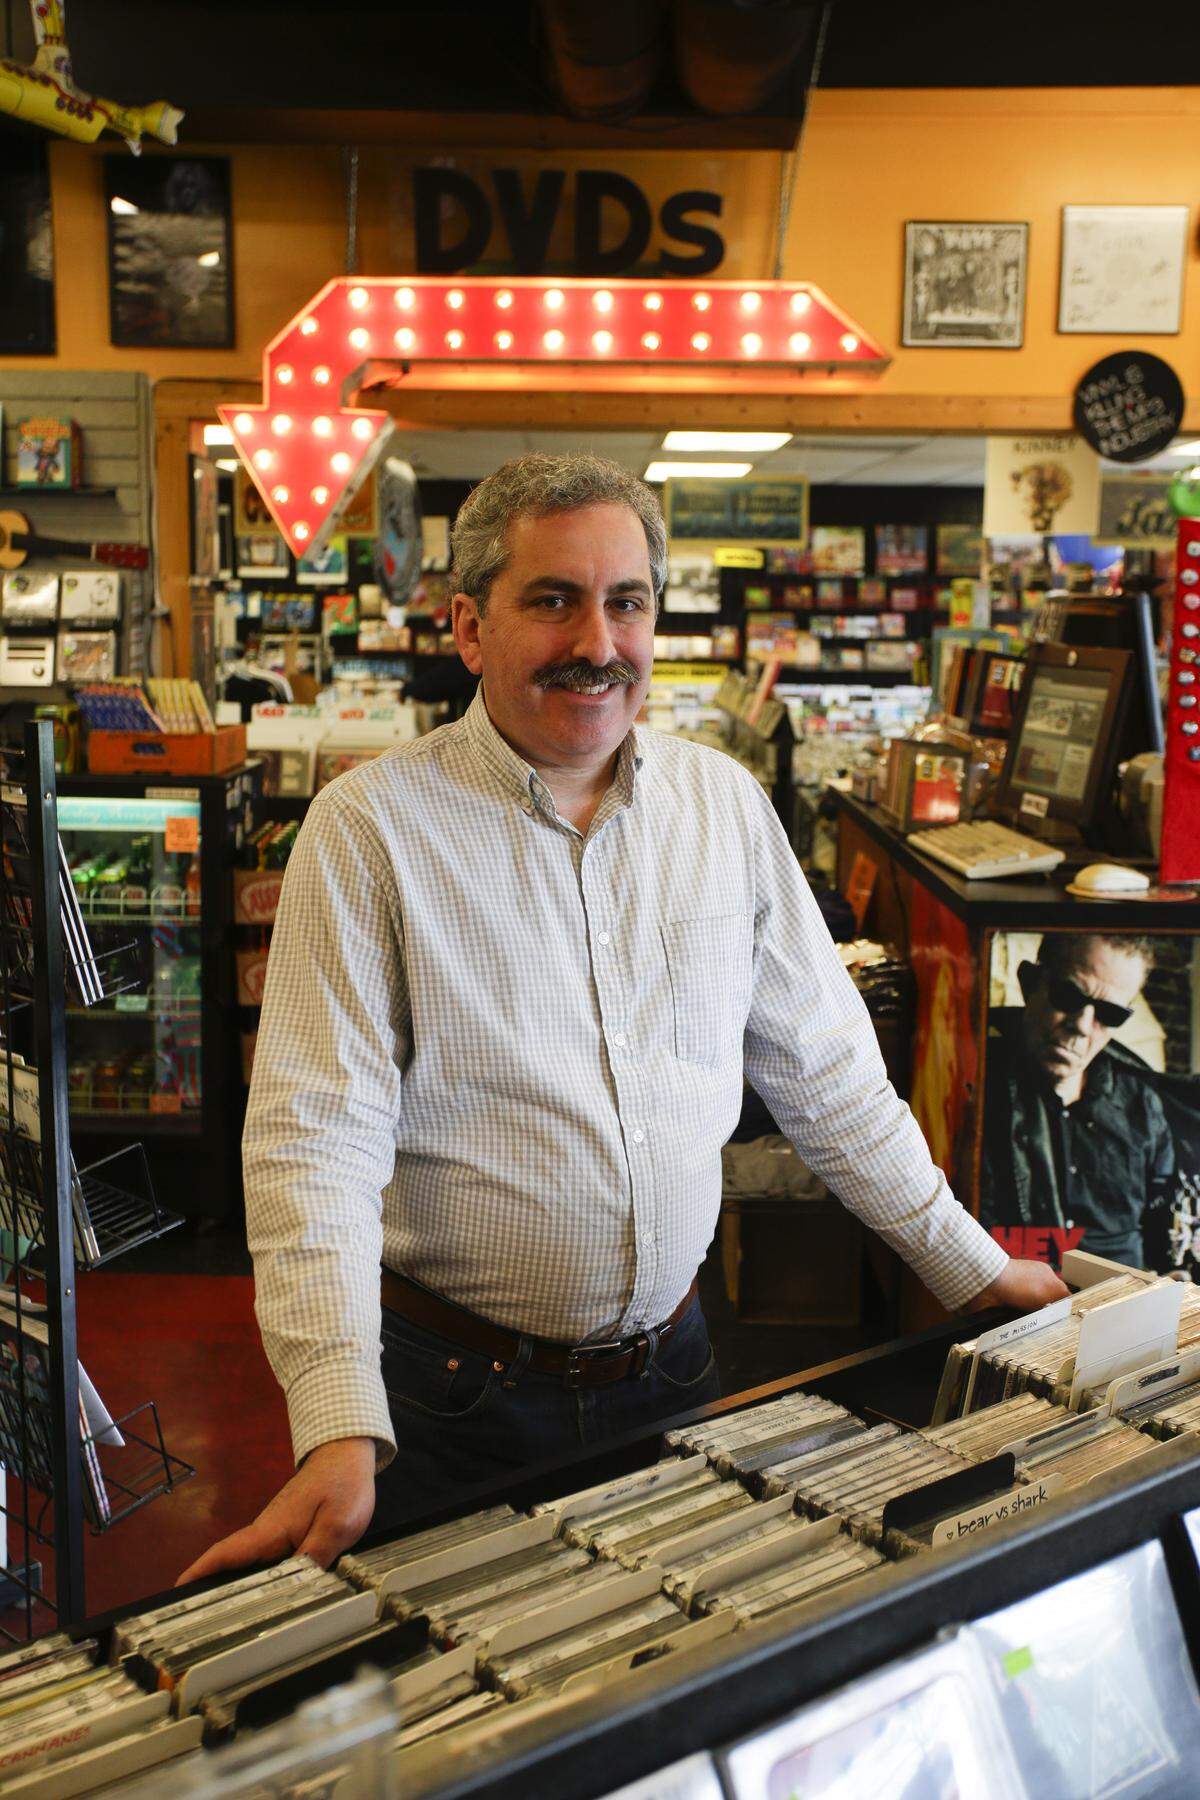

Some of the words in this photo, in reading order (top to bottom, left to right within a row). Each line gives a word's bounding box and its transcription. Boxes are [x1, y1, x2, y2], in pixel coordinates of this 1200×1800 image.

[412, 167, 726, 276] DVDs
[991, 1226, 1086, 1270] HEY
[1012, 1318, 1039, 1337] MISSION
[956, 1512, 994, 1538] bear
[995, 1505, 1009, 1520] vs
[1011, 1485, 1049, 1514] shark
